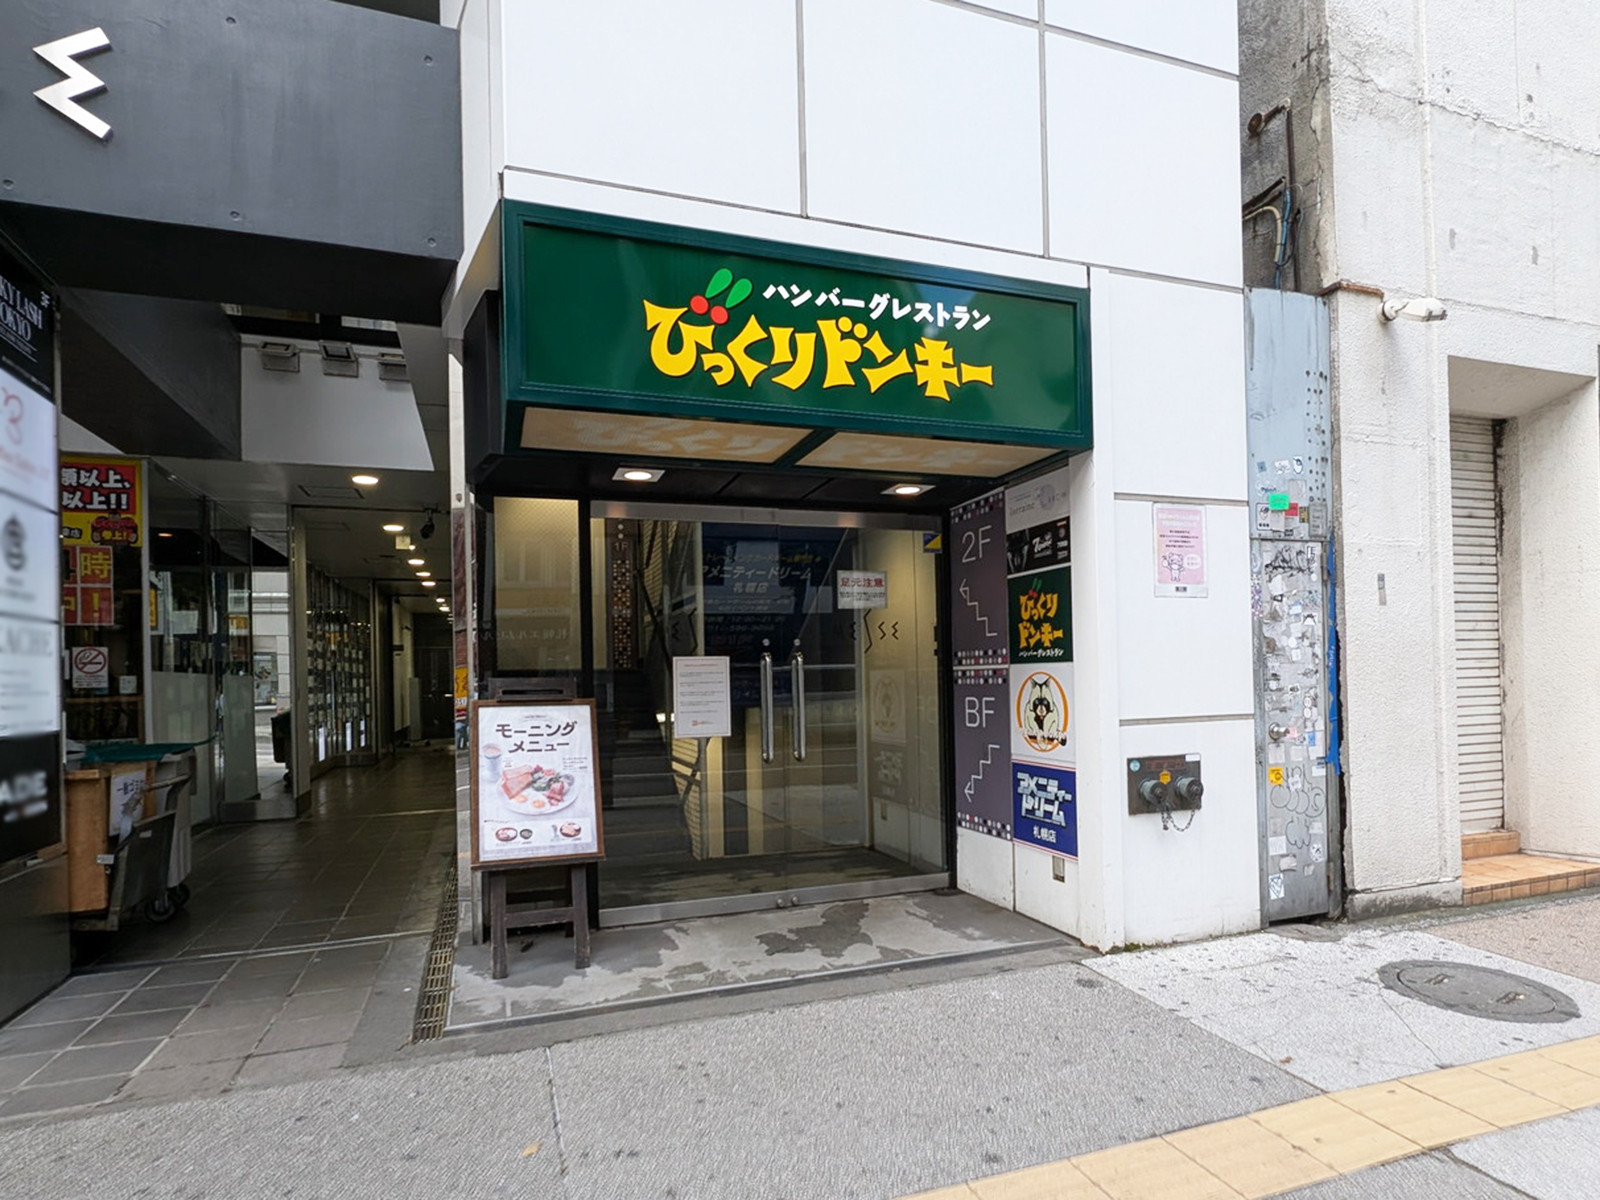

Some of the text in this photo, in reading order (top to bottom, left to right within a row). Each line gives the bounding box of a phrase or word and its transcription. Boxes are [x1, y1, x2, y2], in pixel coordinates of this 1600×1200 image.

[762, 283, 992, 331] ハンバーグレストラン
[643, 297, 994, 402] びっくりドンキー
[961, 525, 993, 564] 2F
[840, 576, 884, 588] 足元注意
[1018, 591, 1060, 621] びっくり
[1018, 620, 1064, 649] ドンキー
[964, 696, 995, 728] BF
[495, 720, 578, 739] モーニング
[508, 740, 570, 754] メニュー
[1021, 794, 1067, 828] ドリーム
